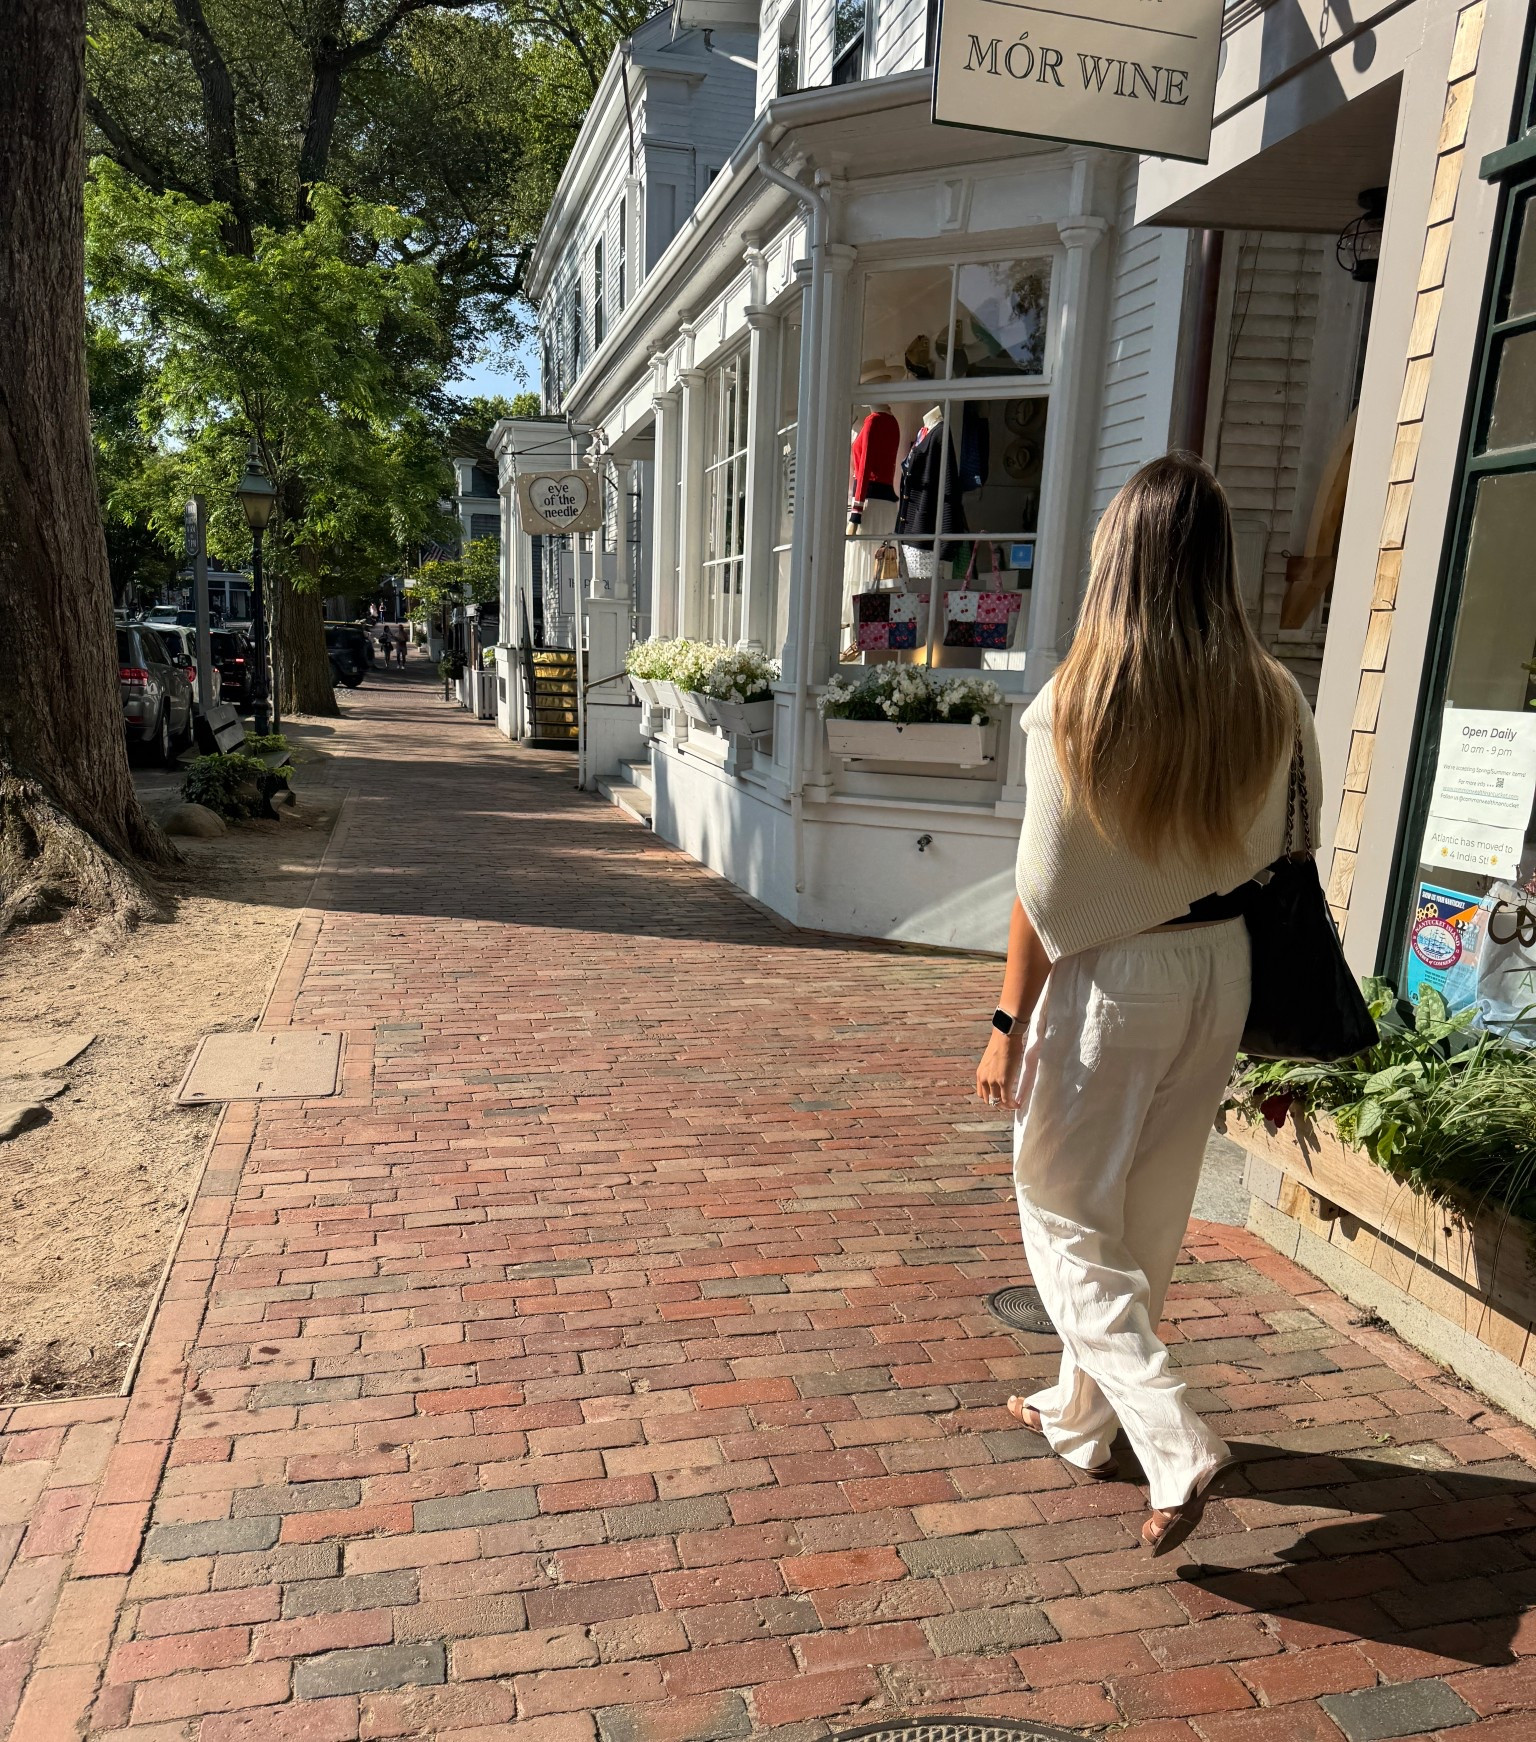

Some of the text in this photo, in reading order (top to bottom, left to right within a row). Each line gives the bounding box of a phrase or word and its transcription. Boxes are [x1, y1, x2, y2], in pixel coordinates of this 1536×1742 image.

[963, 31, 1189, 106] MÓR WINE
[548, 484, 569, 497] eye
[544, 494, 576, 506] of the
[545, 506, 579, 518] needle
[1462, 726, 1517, 742] Open Daily
[1461, 743, 1470, 753] 10
[1470, 746, 1485, 754] am
[1497, 748, 1513, 757] pm
[1431, 832, 1514, 854] Atlantic has moved to
[1449, 850, 1456, 858] 4
[1456, 851, 1478, 863] India
[1414, 919, 1447, 933] NANTUCKET
[1445, 924, 1461, 947] ISLAND
